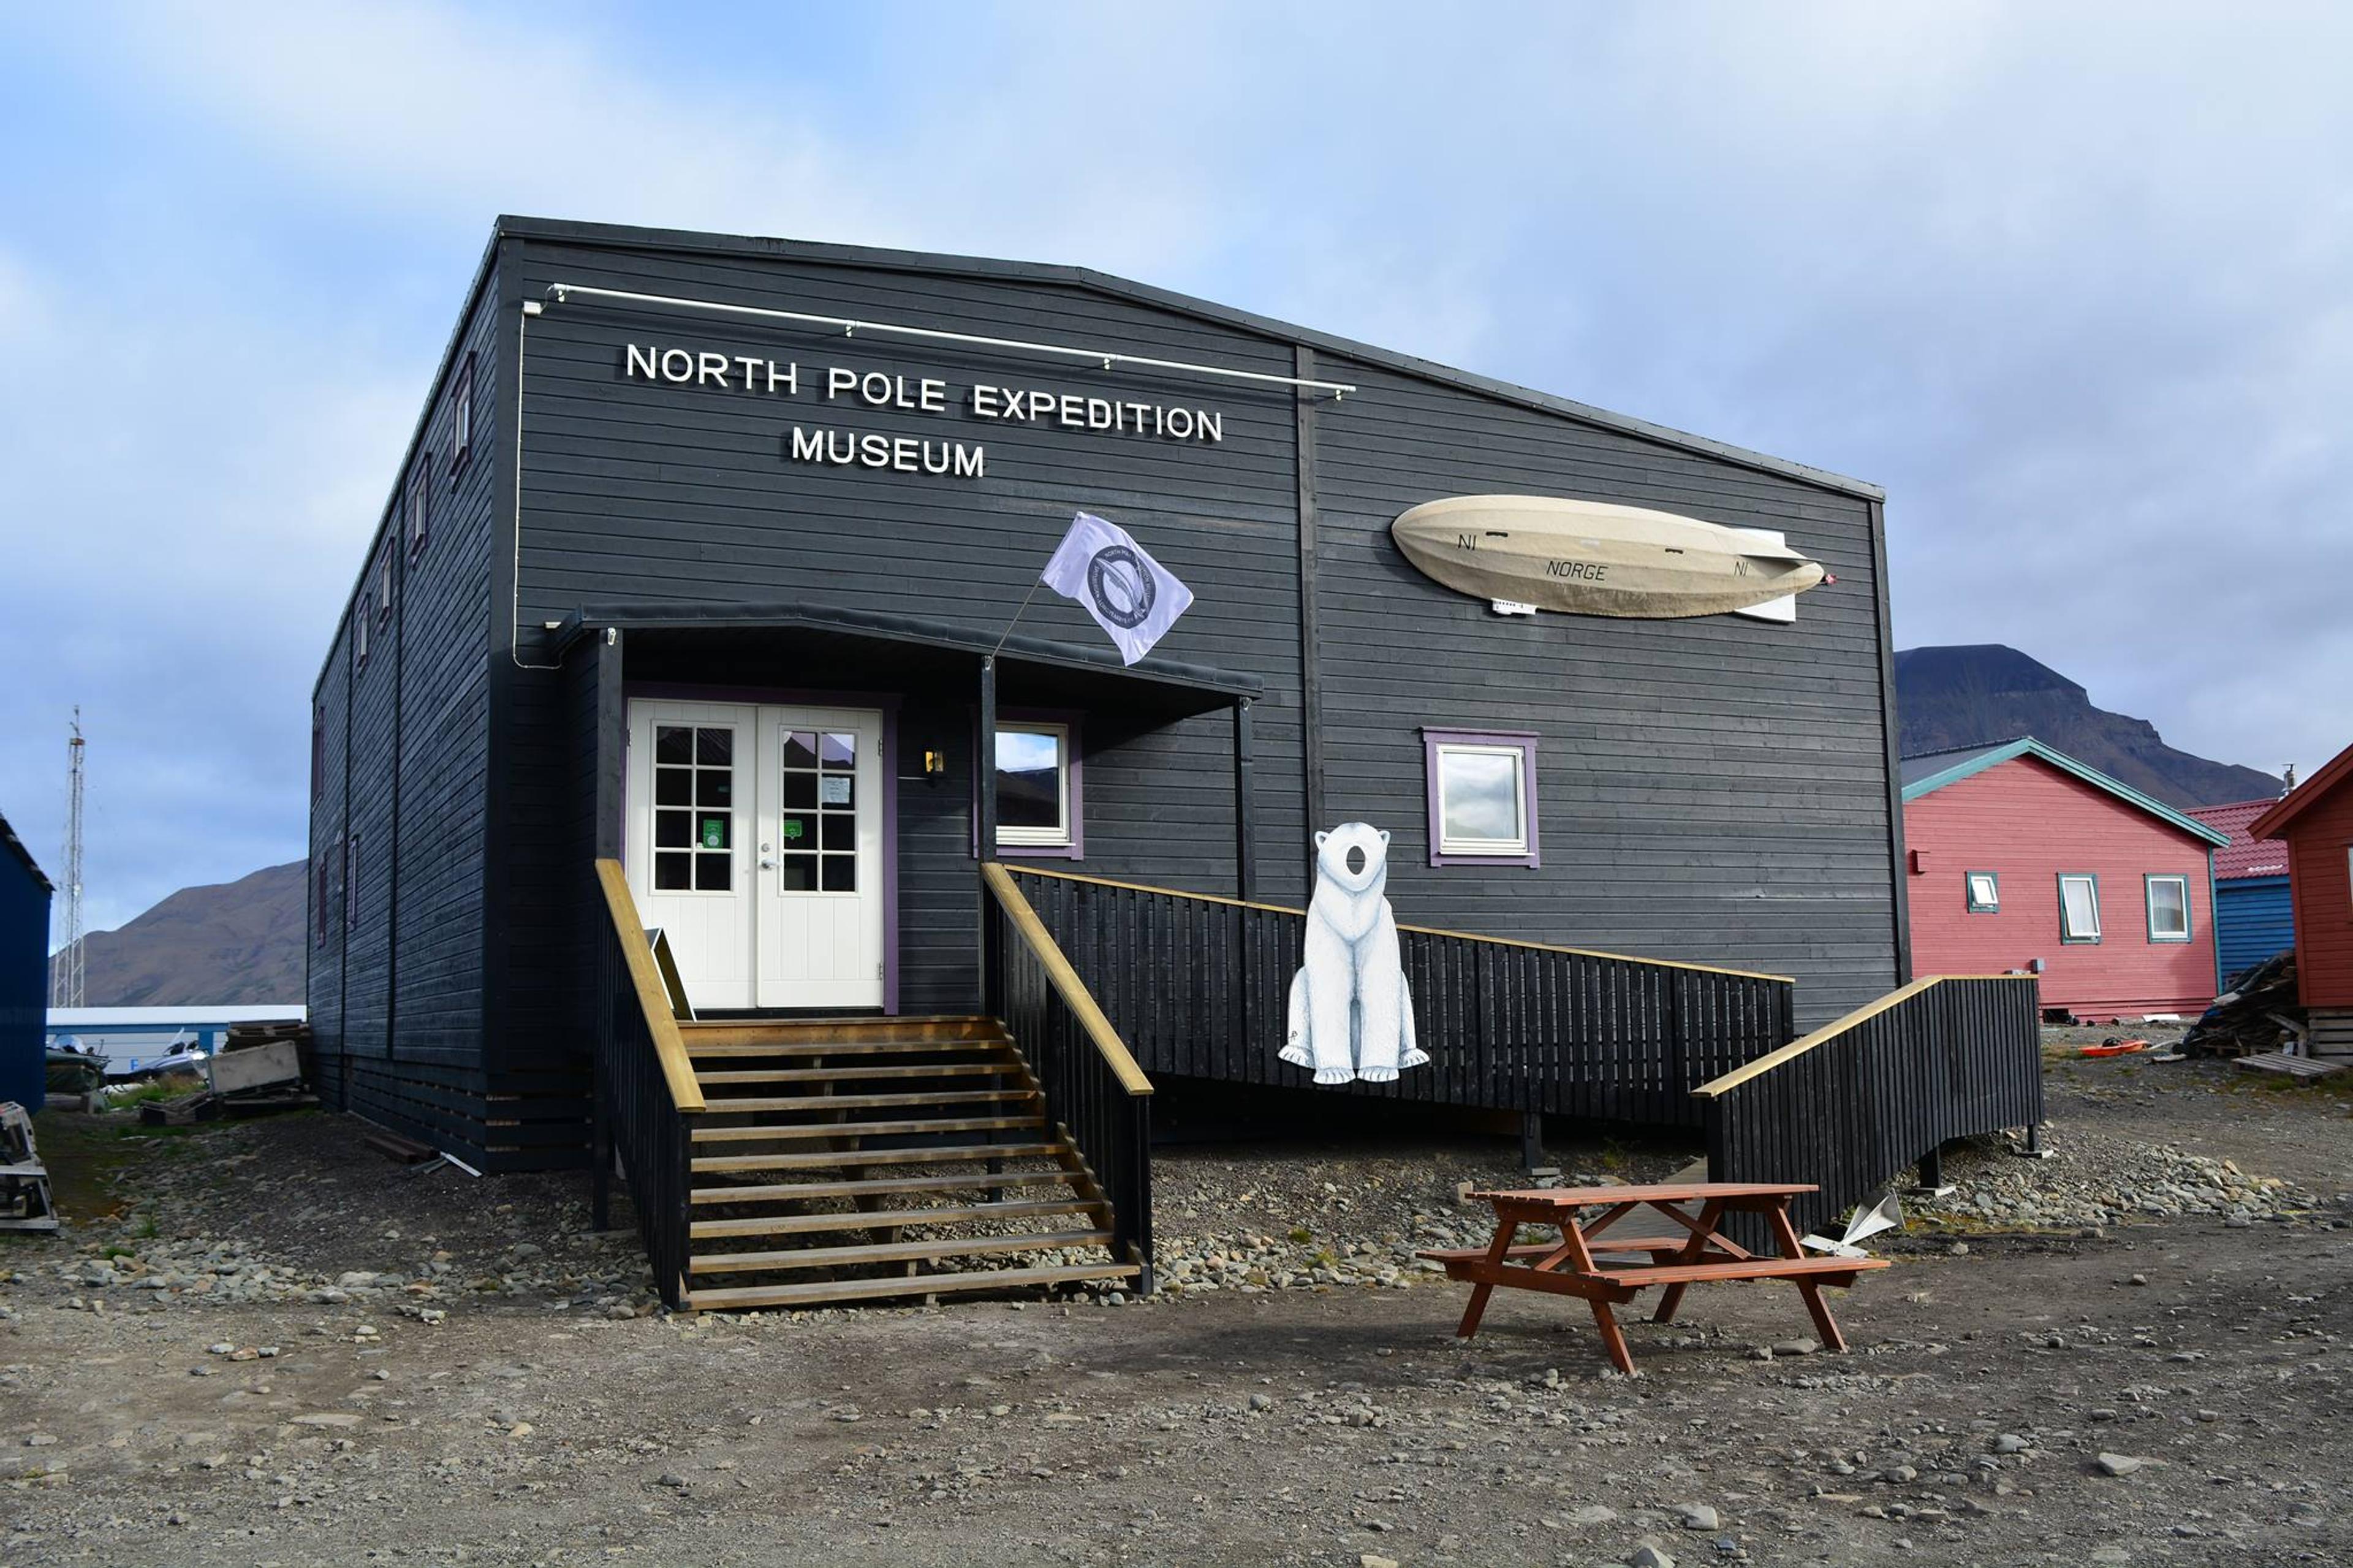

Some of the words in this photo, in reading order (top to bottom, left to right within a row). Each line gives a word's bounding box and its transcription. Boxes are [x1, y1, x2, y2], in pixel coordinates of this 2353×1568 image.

[626, 343, 797, 395] NORTH
[828, 366, 946, 412] POLE
[973, 384, 1223, 442] EXPEDITION
[791, 426, 985, 478] MUSEUM
[1546, 560, 1609, 581] NORGE
